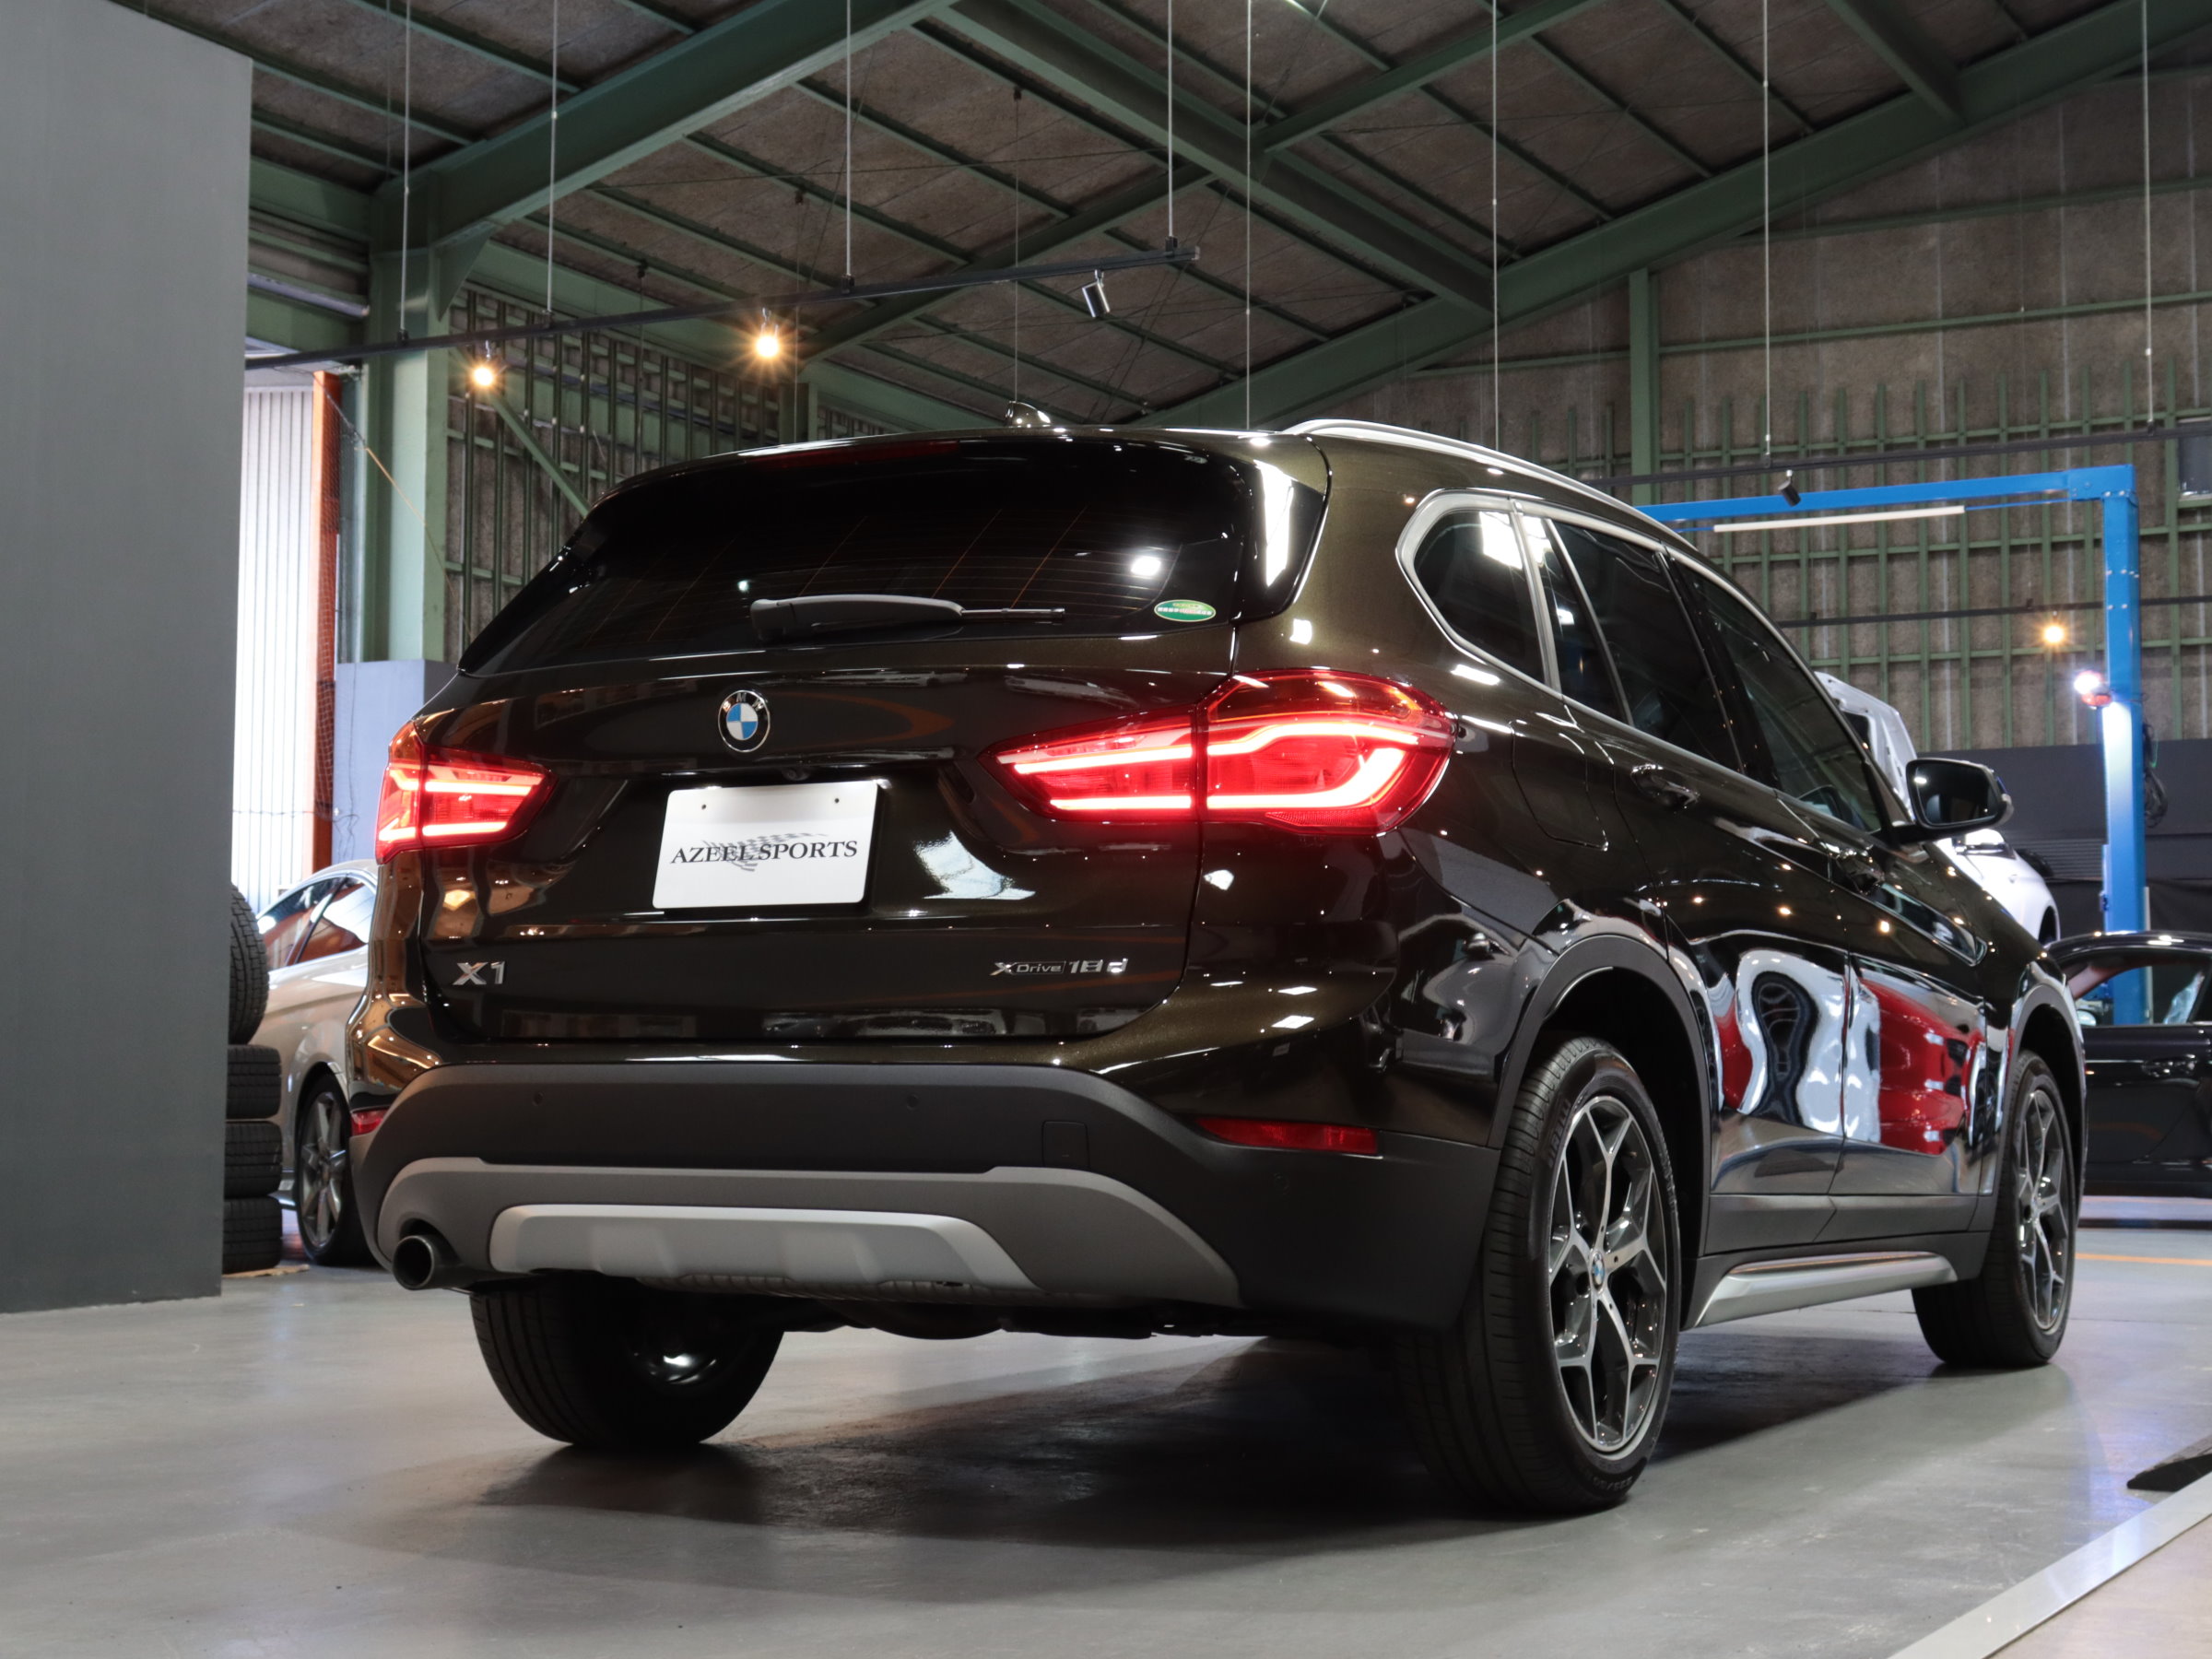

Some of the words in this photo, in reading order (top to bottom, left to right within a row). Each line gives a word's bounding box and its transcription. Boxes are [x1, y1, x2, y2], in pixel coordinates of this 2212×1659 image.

[670, 845, 755, 865] AZEEL
[759, 841, 858, 861] SPORTS
[453, 961, 505, 985] X1
